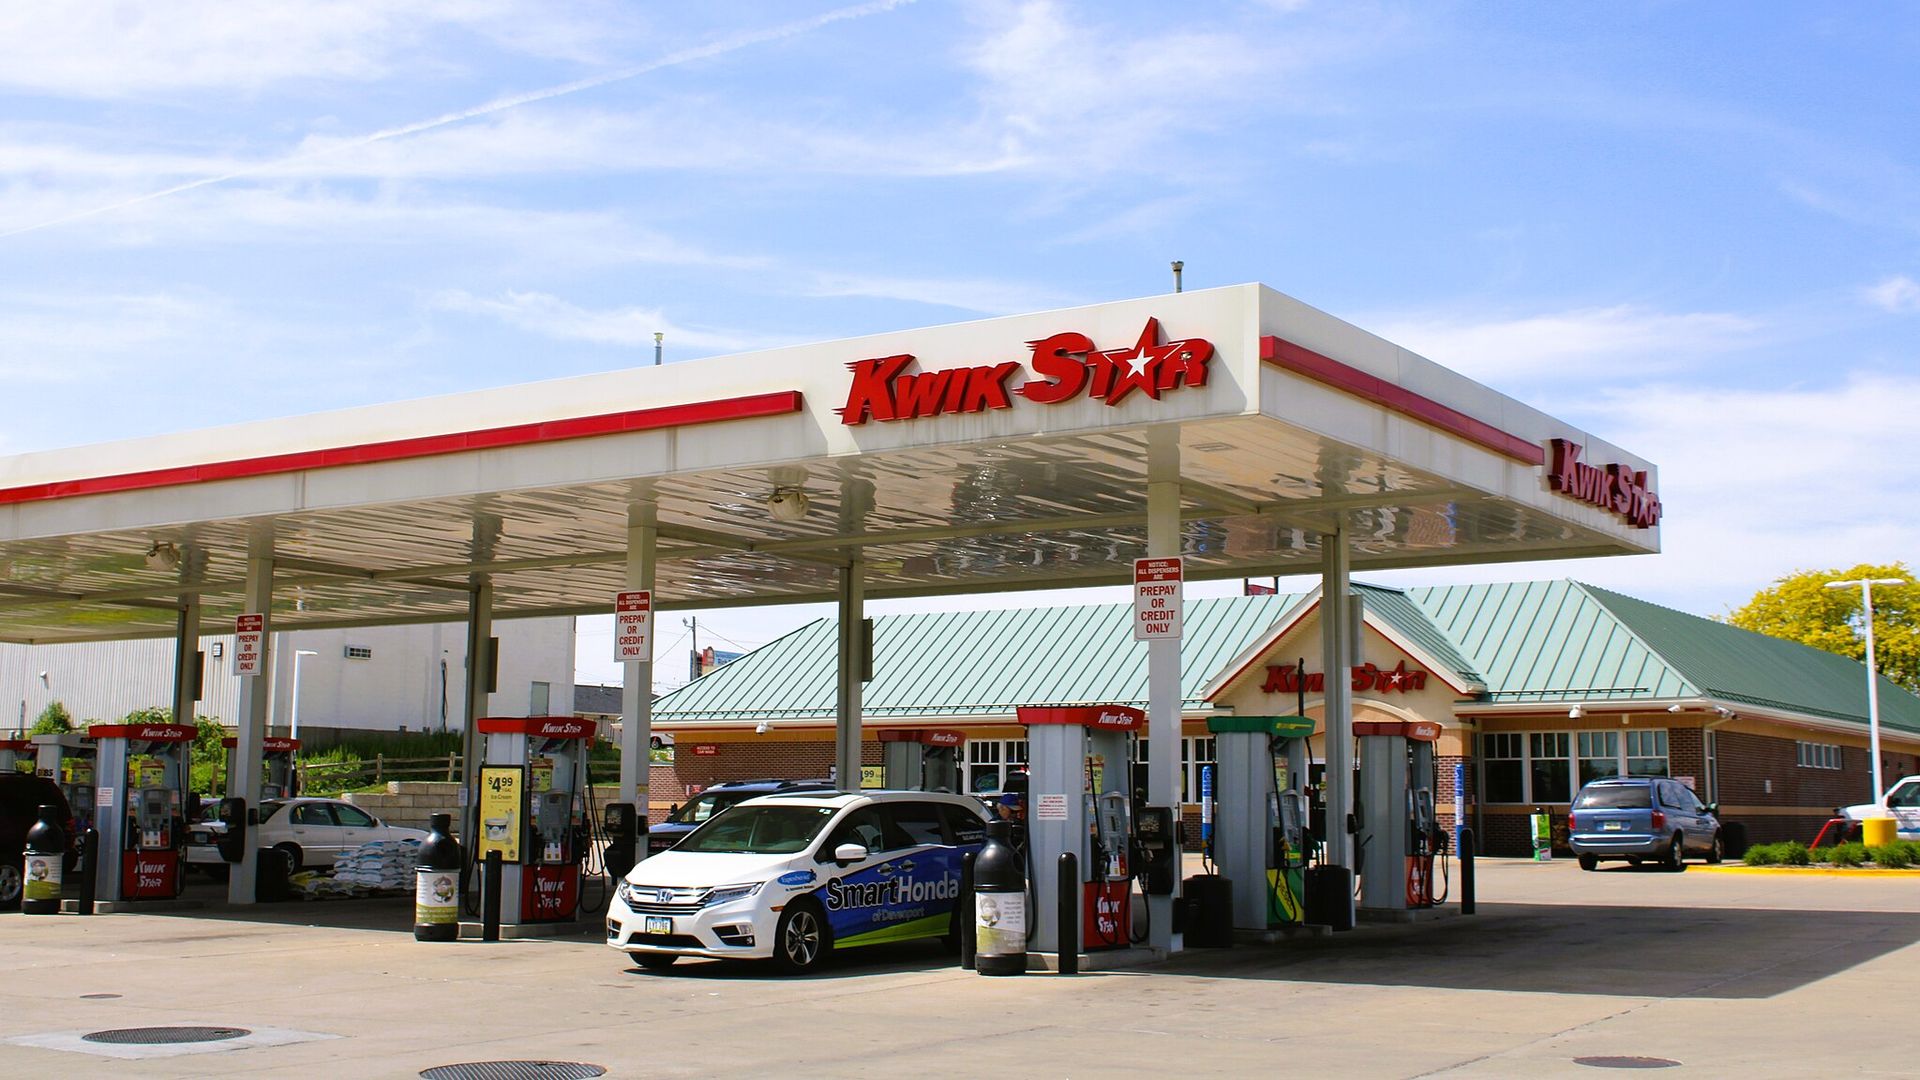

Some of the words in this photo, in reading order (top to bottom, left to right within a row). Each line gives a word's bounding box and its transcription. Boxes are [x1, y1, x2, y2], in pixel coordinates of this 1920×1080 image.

[1140, 585, 1176, 596] PREPAY
[1151, 598, 1165, 608] OR
[619, 615, 646, 624] PREPAY
[1141, 610, 1175, 621] CREDIT
[627, 625, 637, 634] OR
[1146, 623, 1170, 633] ONLY
[619, 636, 644, 645] CREDIT
[622, 647, 640, 655] ONLY
